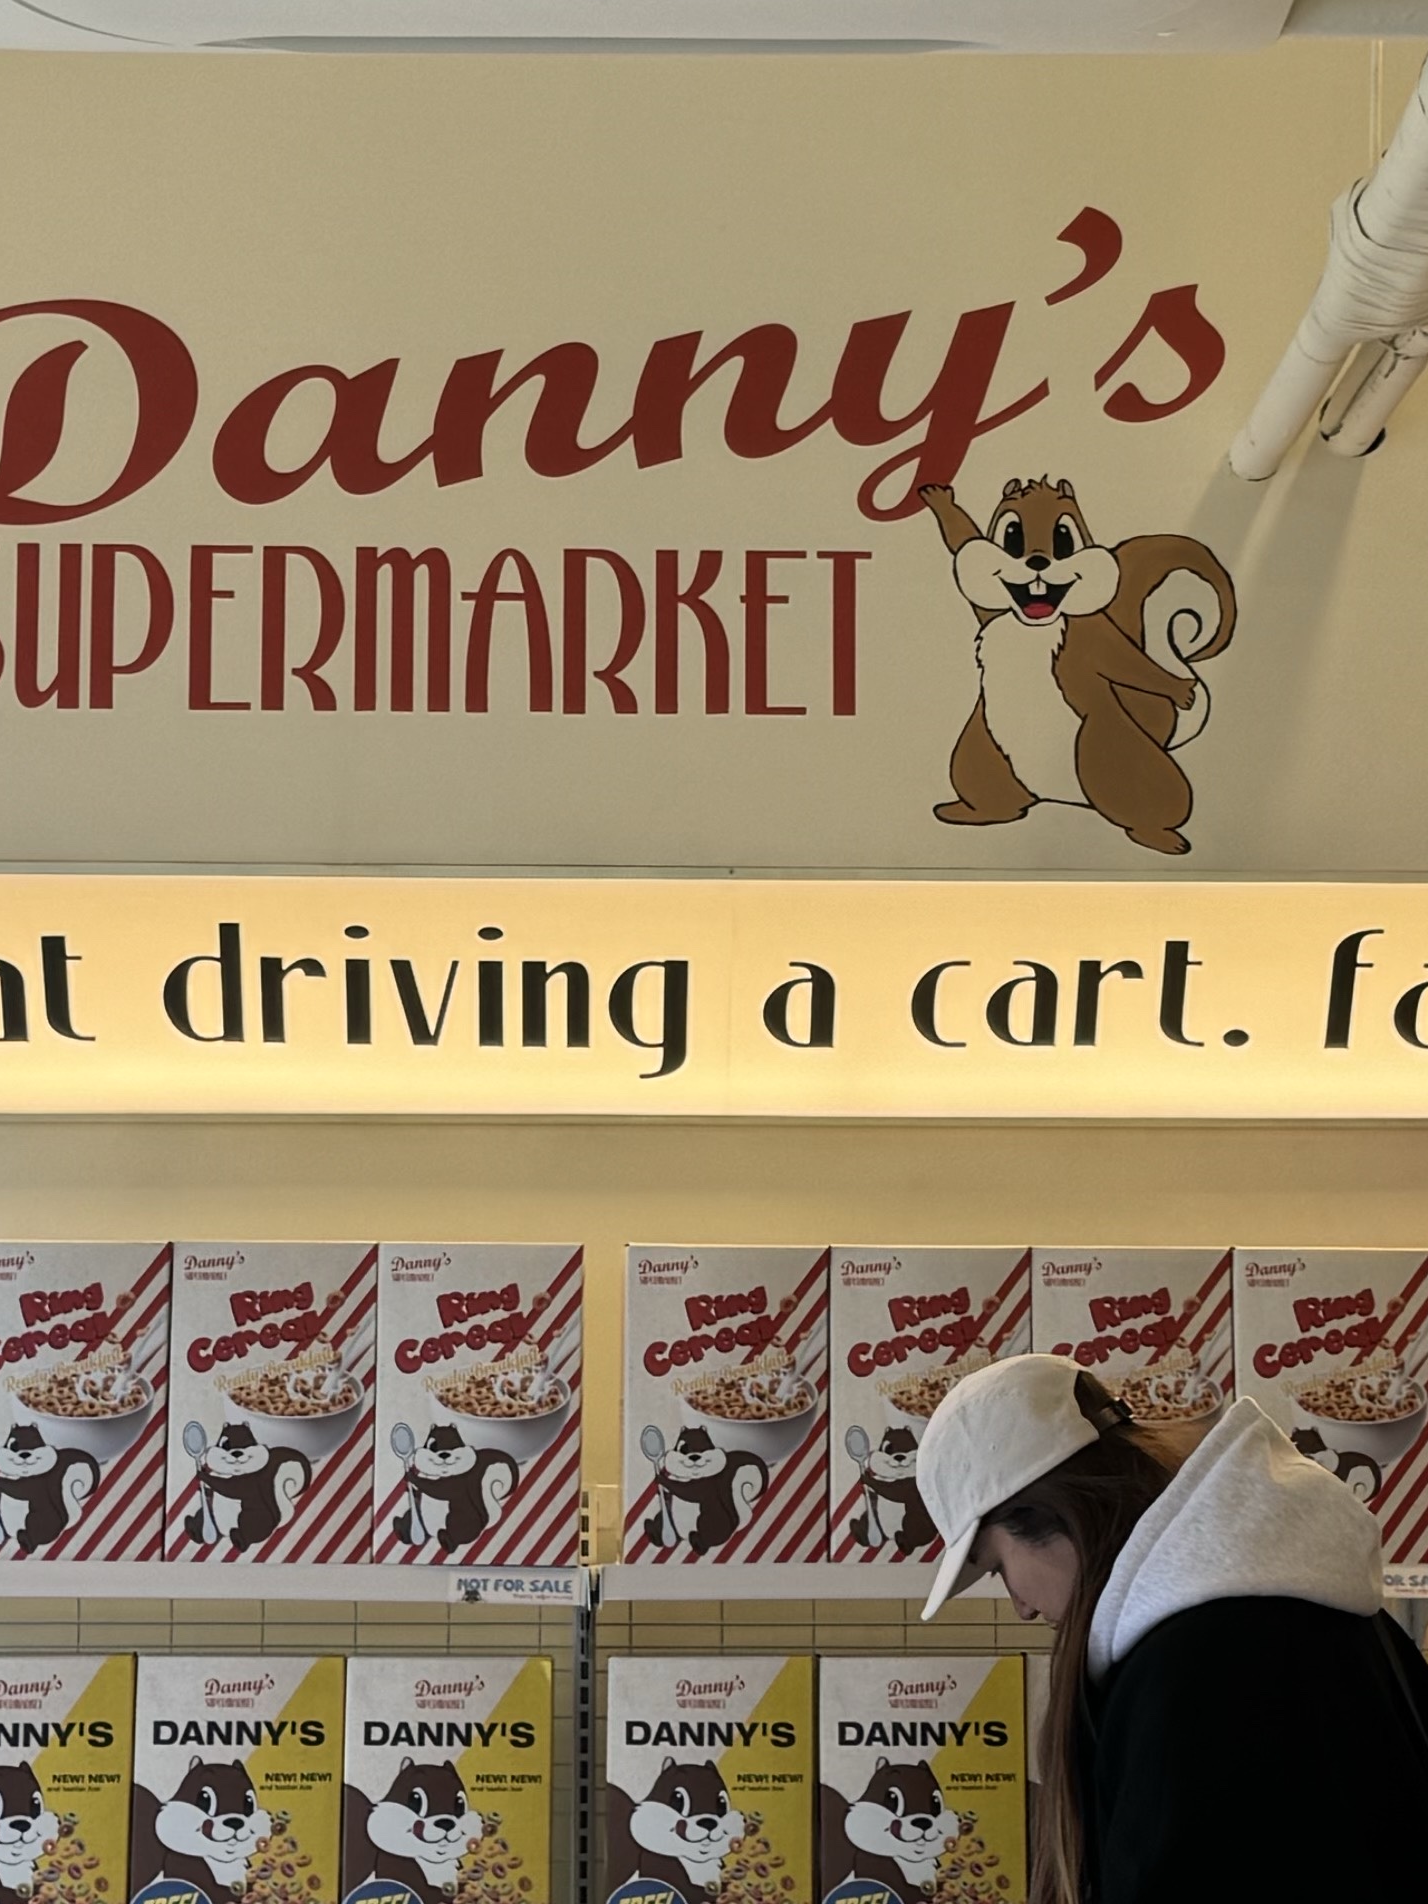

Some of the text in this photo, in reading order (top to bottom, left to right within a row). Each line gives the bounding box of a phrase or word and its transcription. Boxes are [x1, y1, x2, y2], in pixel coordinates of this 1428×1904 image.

[162, 921, 690, 1079] driving
[762, 960, 836, 1049] a
[909, 939, 1252, 1049] cart.
[184, 1251, 244, 1271] Danny's
[391, 1253, 451, 1272] Danny's
[639, 1255, 698, 1275] Danny's
[19, 1282, 103, 1328] Ring
[230, 1282, 314, 1327] Ring
[436, 1283, 520, 1329] Ring
[685, 1286, 767, 1331] Ring
[888, 1287, 971, 1332] Ring
[1089, 1288, 1171, 1332] Ring
[1293, 1288, 1375, 1333] Ring
[187, 1310, 322, 1372] Cereal
[395, 1312, 528, 1374] Cereal
[644, 1314, 776, 1376] Cereal
[847, 1315, 980, 1377] Cereal
[1254, 1316, 1384, 1378] Cereal
[456, 1578, 573, 1594] NOT FOR SALE
[1383, 1574, 1405, 1587] OR
[204, 1674, 274, 1696] Danny's
[415, 1675, 485, 1697] Danny's
[153, 1719, 326, 1746] DANNY'S
[365, 1721, 536, 1747] DANNY'S
[626, 1720, 797, 1747] DANNY'S
[839, 1720, 1009, 1747] DANNY'S
